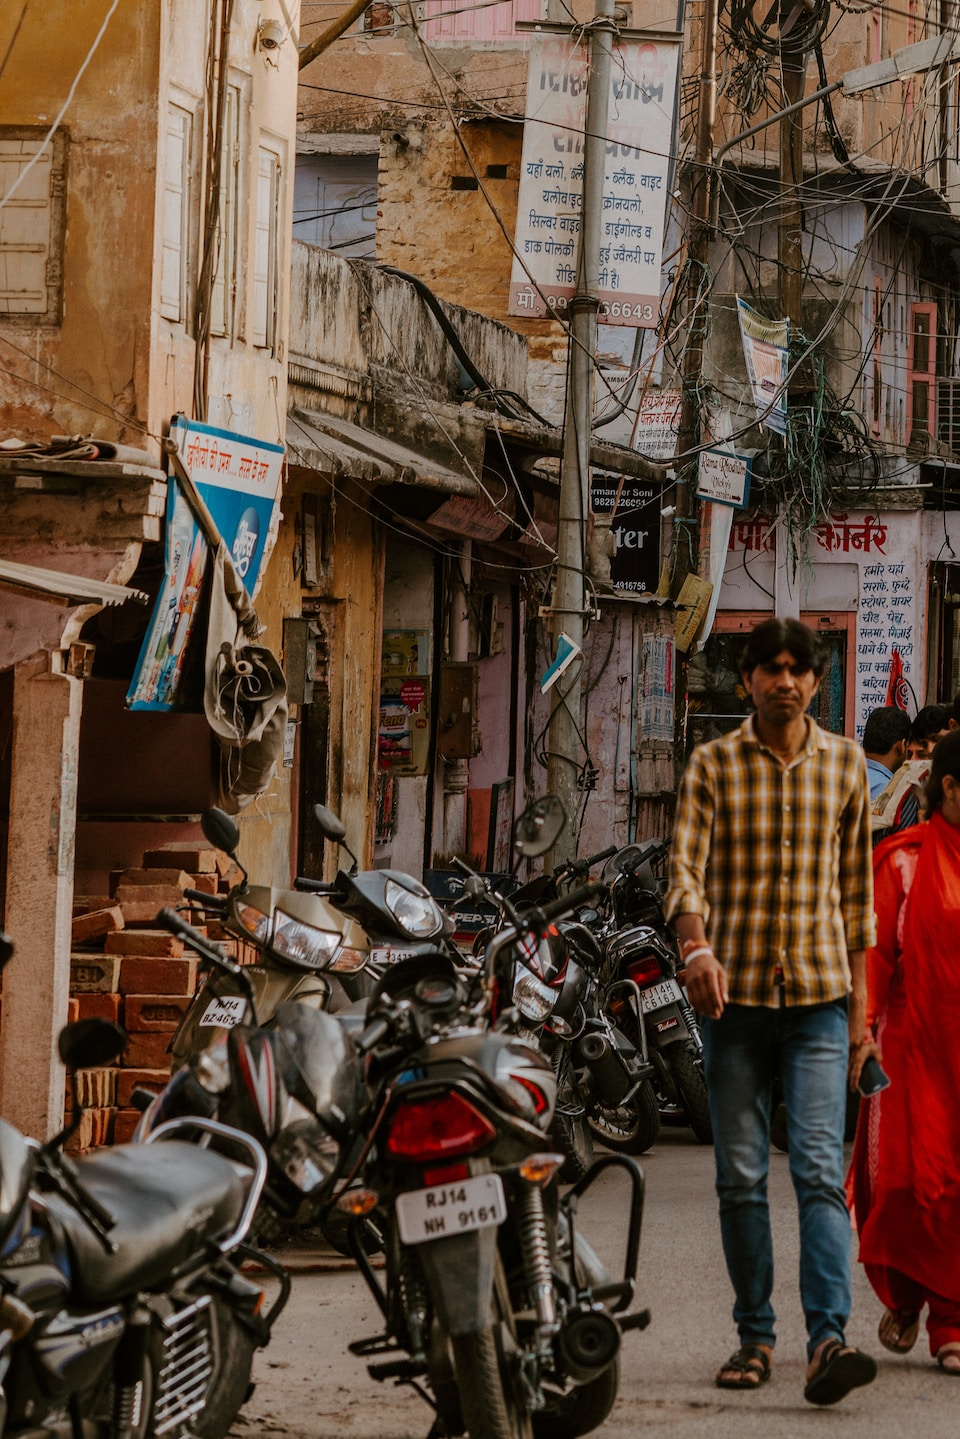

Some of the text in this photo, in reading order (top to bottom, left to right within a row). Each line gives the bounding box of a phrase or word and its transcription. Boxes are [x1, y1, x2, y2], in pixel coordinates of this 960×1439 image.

[640, 173, 662, 191] वाइट
[644, 252, 656, 266] पर
[633, 488, 653, 497] Soni
[454, 912, 496, 924] PEPSI
[426, 1187, 467, 1209] RJ14
[424, 1205, 497, 1235] NH 9161
